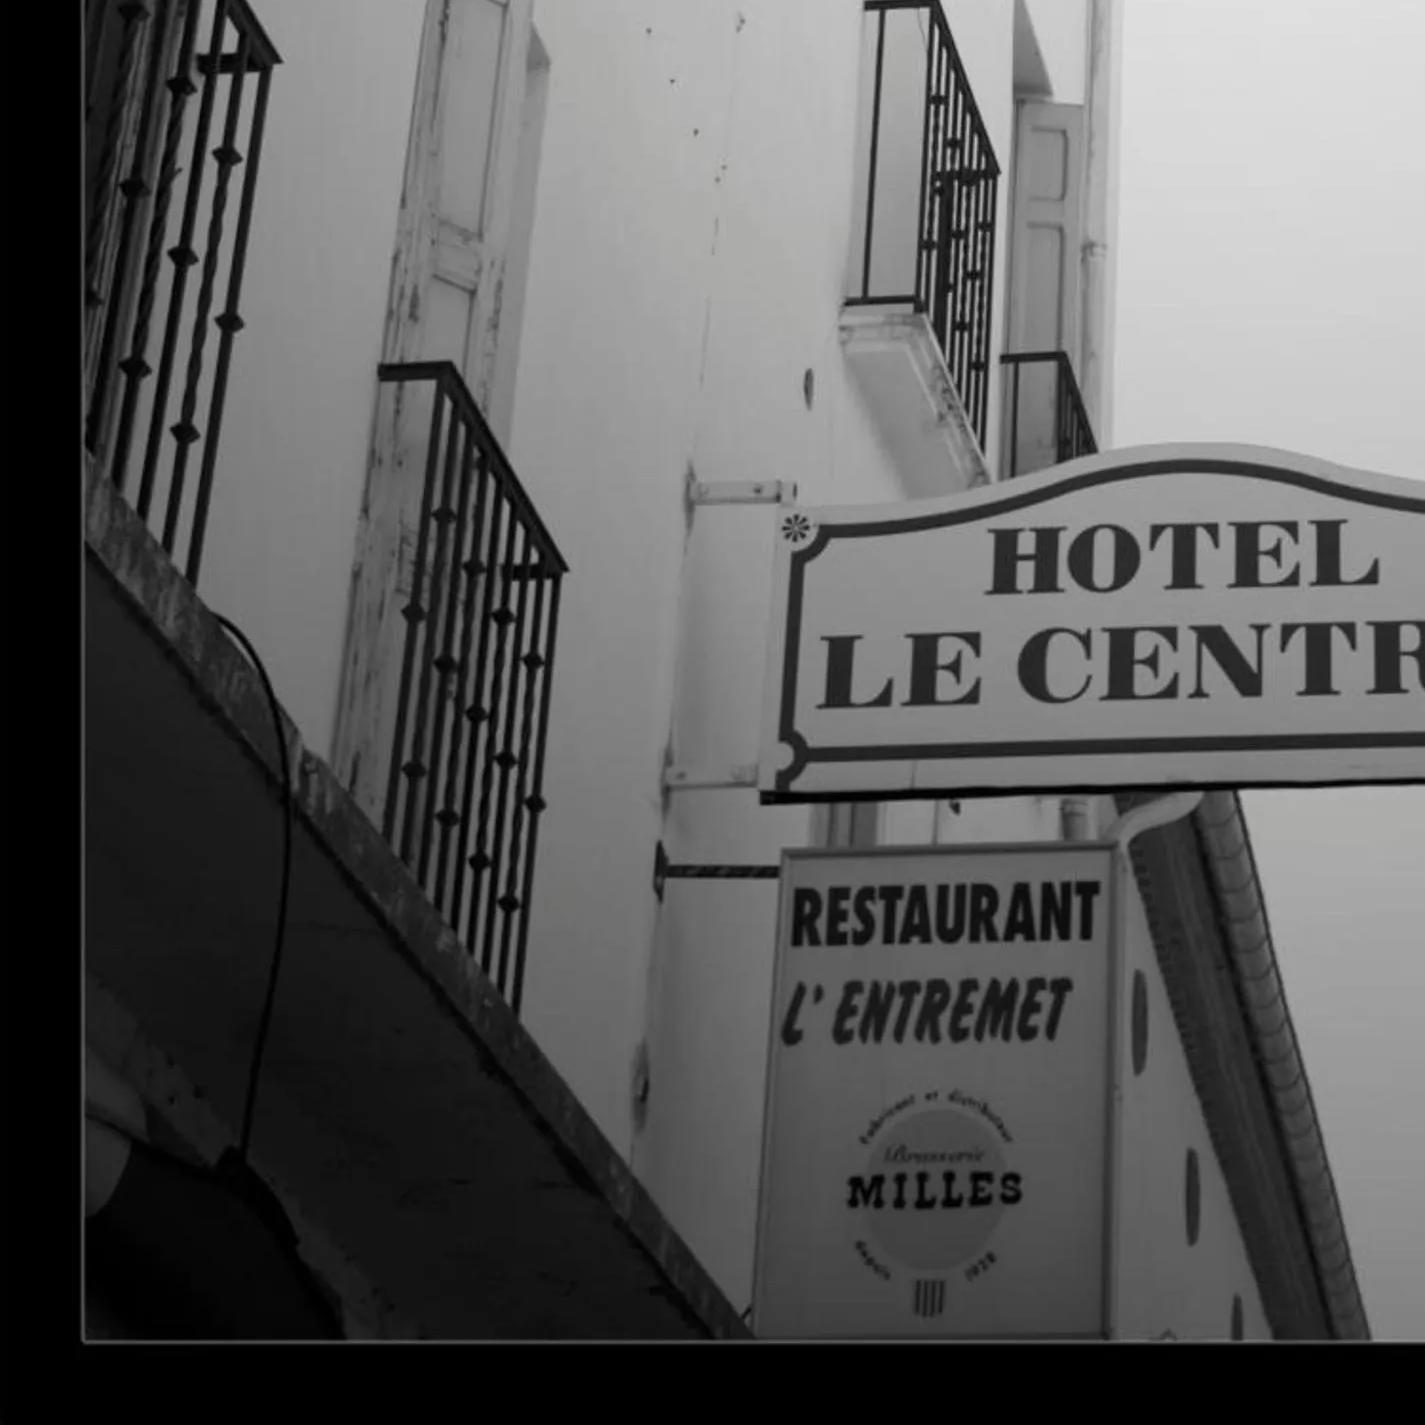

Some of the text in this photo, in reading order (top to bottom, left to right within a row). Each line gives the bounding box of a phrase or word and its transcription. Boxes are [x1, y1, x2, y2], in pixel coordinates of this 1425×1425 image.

[983, 519, 1380, 596] HOTEL
[815, 631, 982, 710] LE
[790, 880, 1101, 948] RESTAURANT
[847, 1170, 1022, 1211] MILLES
